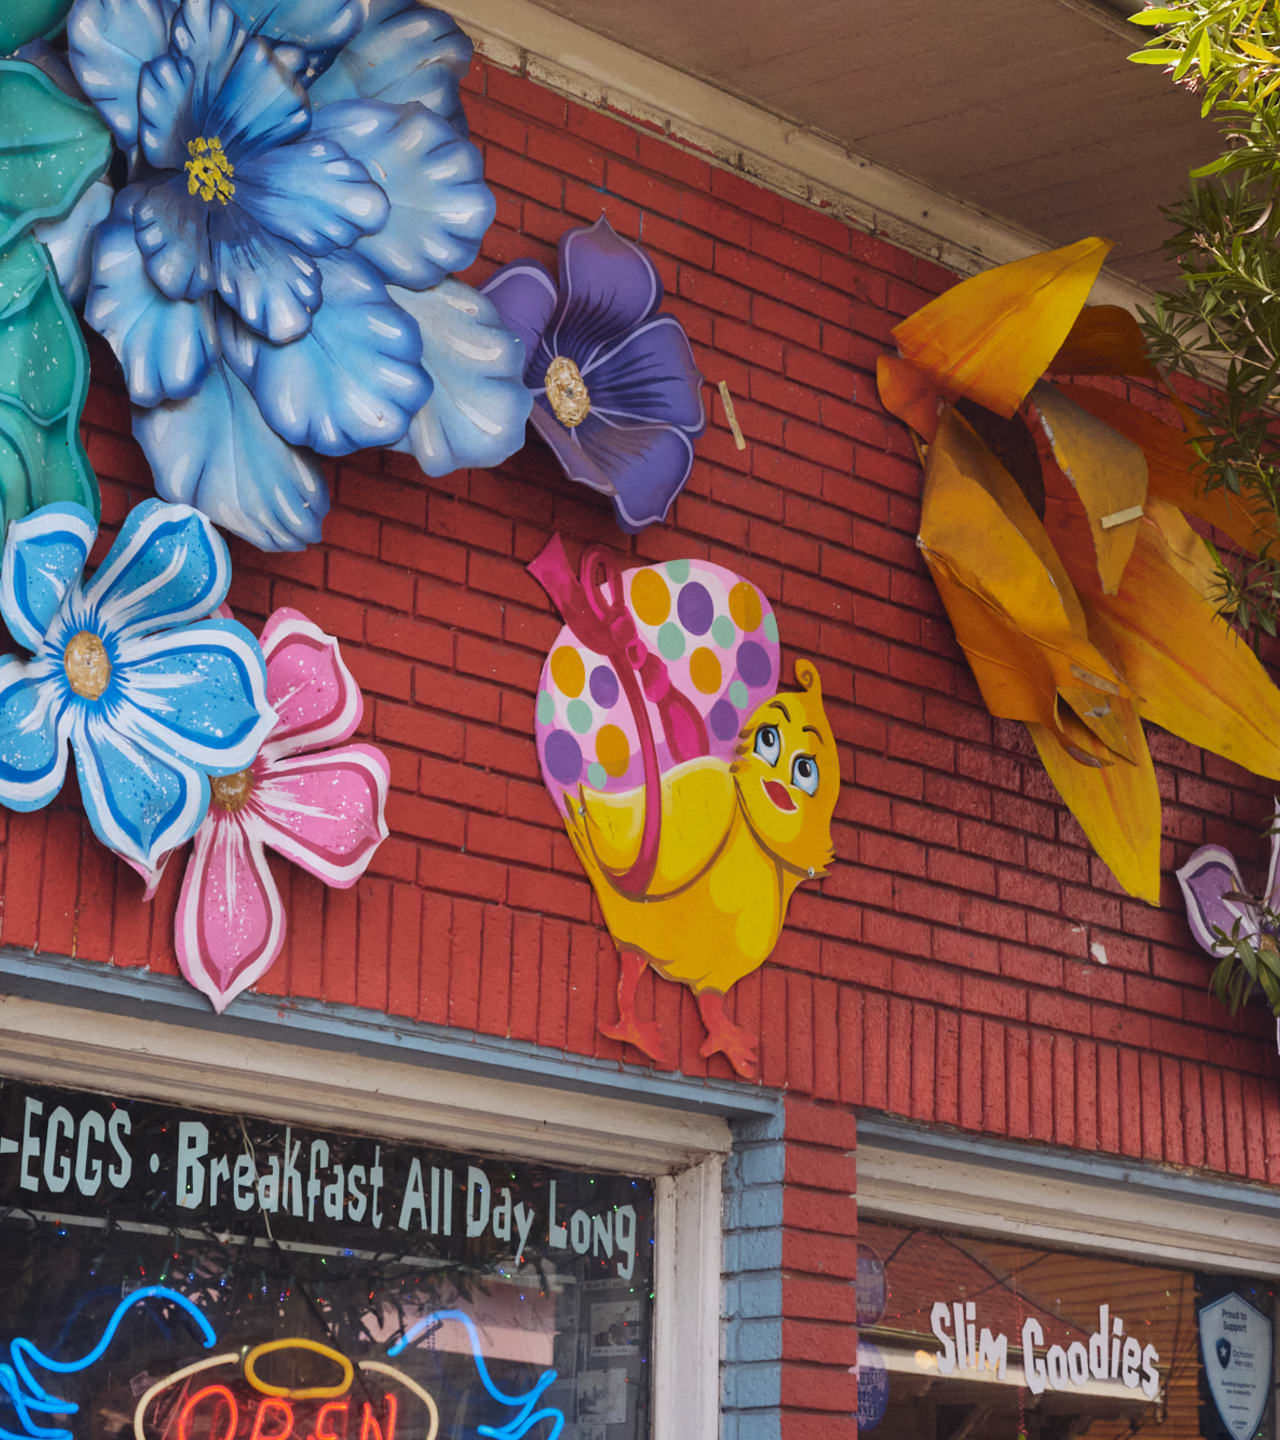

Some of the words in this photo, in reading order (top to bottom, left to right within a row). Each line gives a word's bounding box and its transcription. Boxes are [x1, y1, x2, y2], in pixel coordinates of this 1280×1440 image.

[176, 1120, 384, 1230] Breakfast
[398, 1157, 453, 1236] All
[465, 1166, 536, 1264] Day
[547, 1179, 637, 1280] Long
[1221, 1308, 1239, 1320] Proud
[1240, 1310, 1247, 1320] to
[1223, 1321, 1247, 1332] Support
[929, 1301, 1009, 1381] Slim
[1022, 1303, 1161, 1401] Goodies
